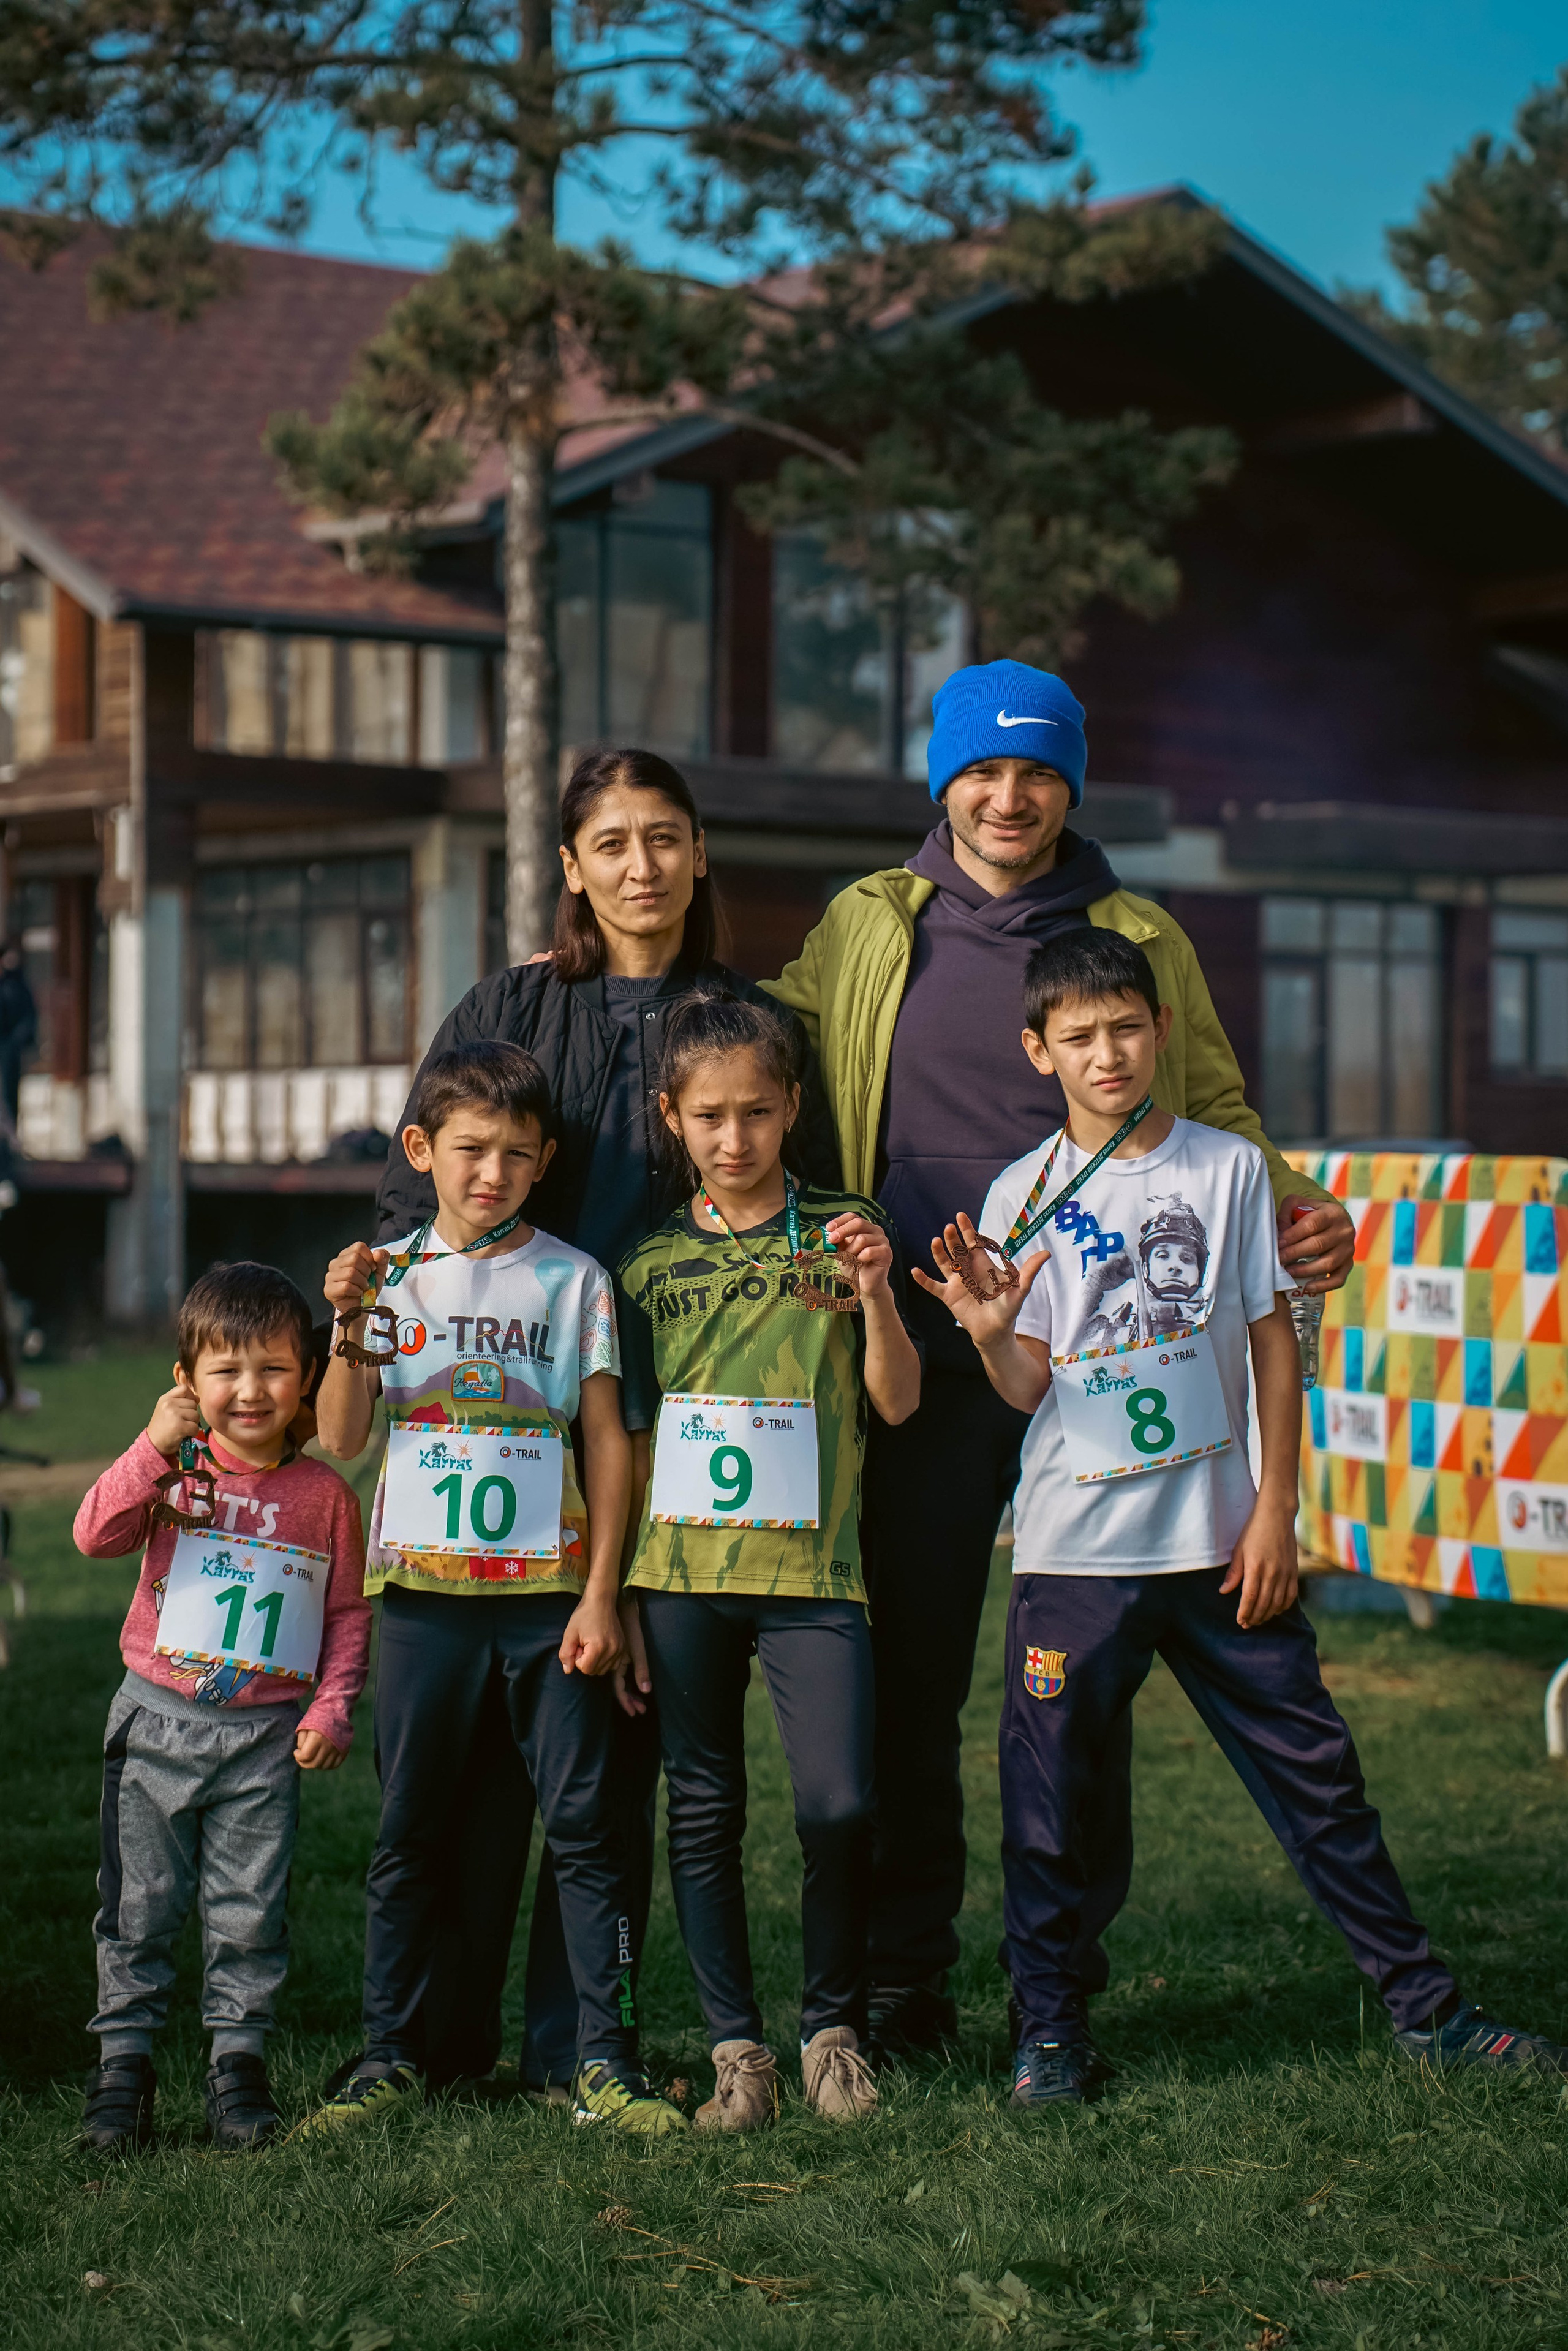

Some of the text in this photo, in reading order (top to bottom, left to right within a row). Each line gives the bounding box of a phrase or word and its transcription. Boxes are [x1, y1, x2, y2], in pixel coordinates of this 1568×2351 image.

[1103, 1140, 1115, 1155] Karras
[1043, 1204, 1057, 1218] Karras
[492, 1225, 511, 1238] Karras
[1014, 1231, 1028, 1248] ТРЕЙЛ
[832, 1272, 853, 1285] Karras
[657, 1286, 711, 1323] JUST
[721, 1275, 768, 1302] GO
[456, 1351, 553, 1373] orienteering&trailrunning
[1083, 1375, 1138, 1397] Karras
[680, 1421, 727, 1442] Karras
[1126, 1387, 1175, 1454] 8
[419, 1449, 473, 1471] Karras
[709, 1444, 753, 1511] 9
[432, 1473, 517, 1542] 10
[200, 1556, 256, 1583] Karras
[830, 1561, 850, 1577] GS
[214, 1584, 285, 1658] 11
[1034, 1668, 1050, 1677] FCB
[618, 1916, 635, 2028] FILA PRO
